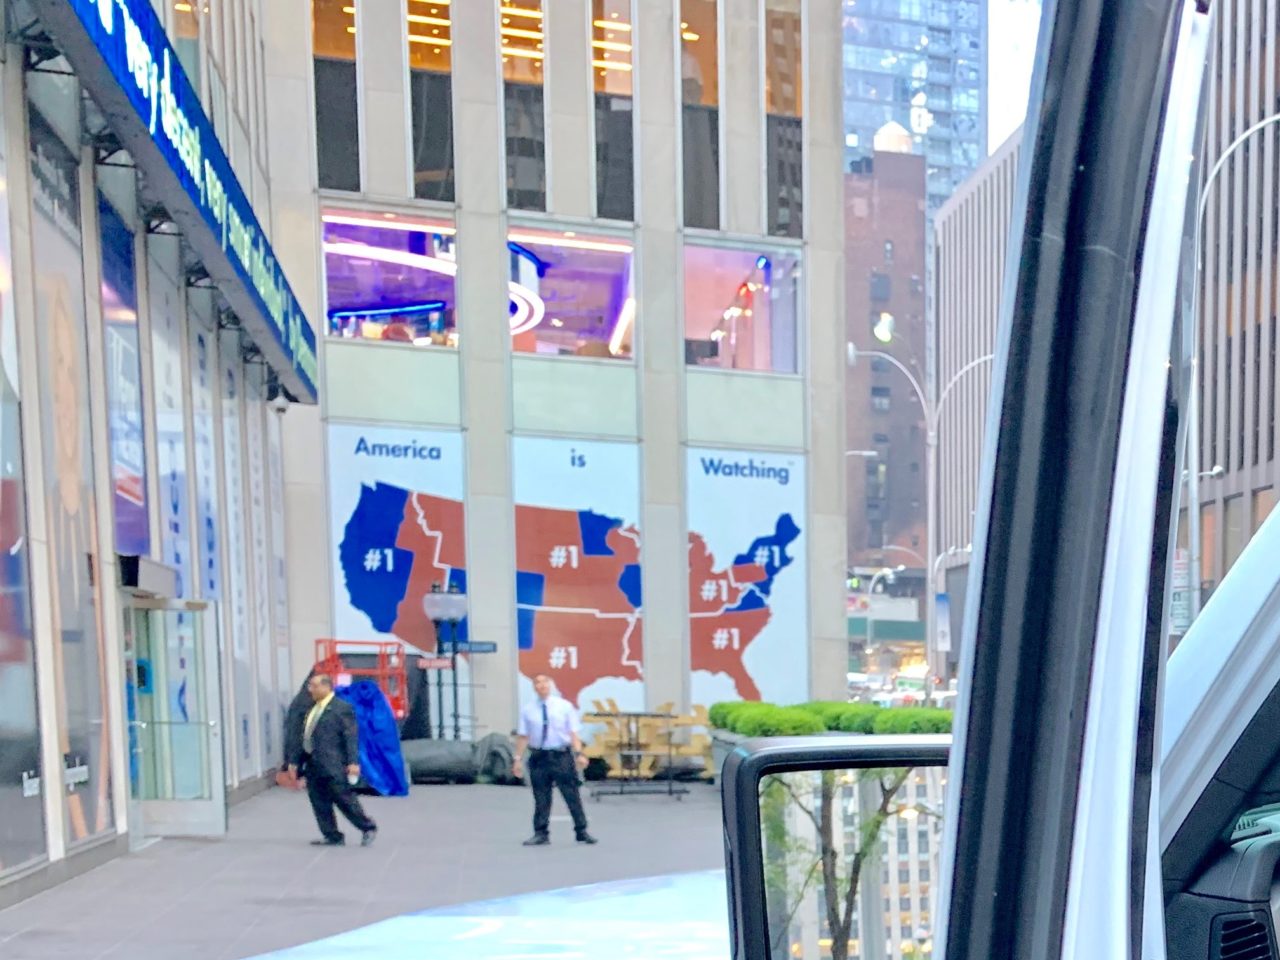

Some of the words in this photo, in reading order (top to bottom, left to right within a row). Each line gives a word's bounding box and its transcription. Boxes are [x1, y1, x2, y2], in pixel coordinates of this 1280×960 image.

[354, 435, 442, 460] America
[570, 447, 587, 468] is
[700, 456, 790, 486] Watching
[363, 548, 394, 572] #1
[549, 545, 579, 569] #1
[753, 545, 780, 568] #1
[701, 579, 728, 602] #1
[712, 628, 739, 650] #1
[549, 646, 579, 669] #1
